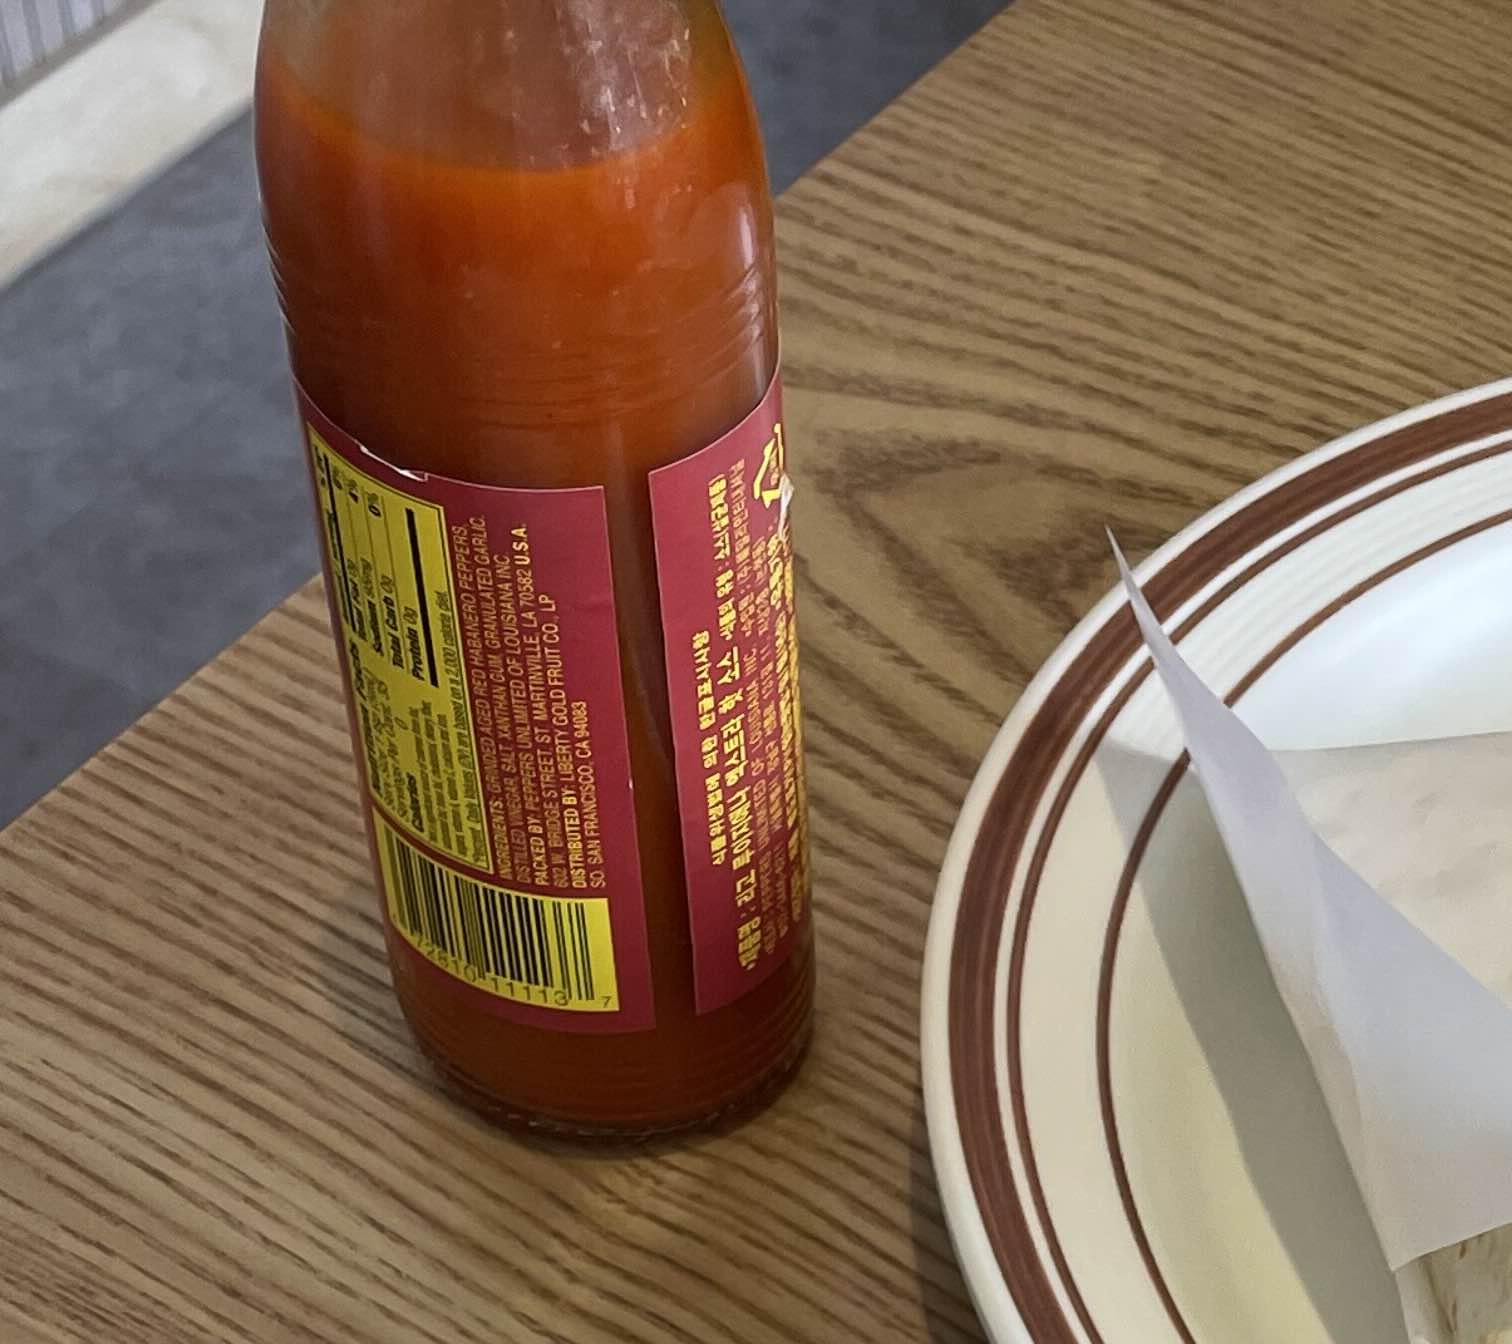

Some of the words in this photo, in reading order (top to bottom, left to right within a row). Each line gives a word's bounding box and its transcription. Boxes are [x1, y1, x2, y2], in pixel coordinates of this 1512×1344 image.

[511, 523, 531, 565] U.S.A.
[476, 568, 501, 648] GRANULATED
[516, 568, 535, 609] 70582
[538, 593, 556, 613] LP
[383, 596, 400, 632] Carb
[460, 593, 484, 665] HABANERO
[497, 583, 522, 655] LOUISIANA
[521, 611, 538, 628] LA
[407, 626, 426, 682] Protein
[506, 657, 524, 677] OF
[545, 647, 566, 686] FRUIT
[715, 645, 741, 685] 소스
[471, 669, 488, 696] RED
[692, 630, 716, 731] 한글표시사항
[717, 688, 743, 714] 핫
[475, 699, 494, 734] AGED
[492, 684, 513, 741] XANTHAN
[509, 680, 533, 749] UNLIMITED
[550, 688, 569, 726] GOLD
[571, 701, 590, 739] 94083
[746, 680, 764, 752] LOUISIANA
[480, 737, 501, 793] GRINDED
[553, 728, 576, 781] LIBERTY
[575, 740, 592, 759] CA
[701, 733, 719, 769] 의한
[721, 714, 749, 786] 엑스트라
[750, 758, 766, 777] OF
[518, 751, 541, 811] PEPPERS
[489, 797, 513, 880] INGREDIENTS:
[544, 801, 565, 848] BRIDGE
[704, 771, 728, 865] 식품위생법에
[727, 786, 754, 870] 루이지애나
[511, 829, 532, 884] DISTILLED
[529, 836, 550, 886] PACKED
[563, 808, 588, 889] DISTRIBUTED
[587, 840, 604, 866] SAN
[490, 976, 570, 1007] 11113
[600, 994, 613, 1009] 7
